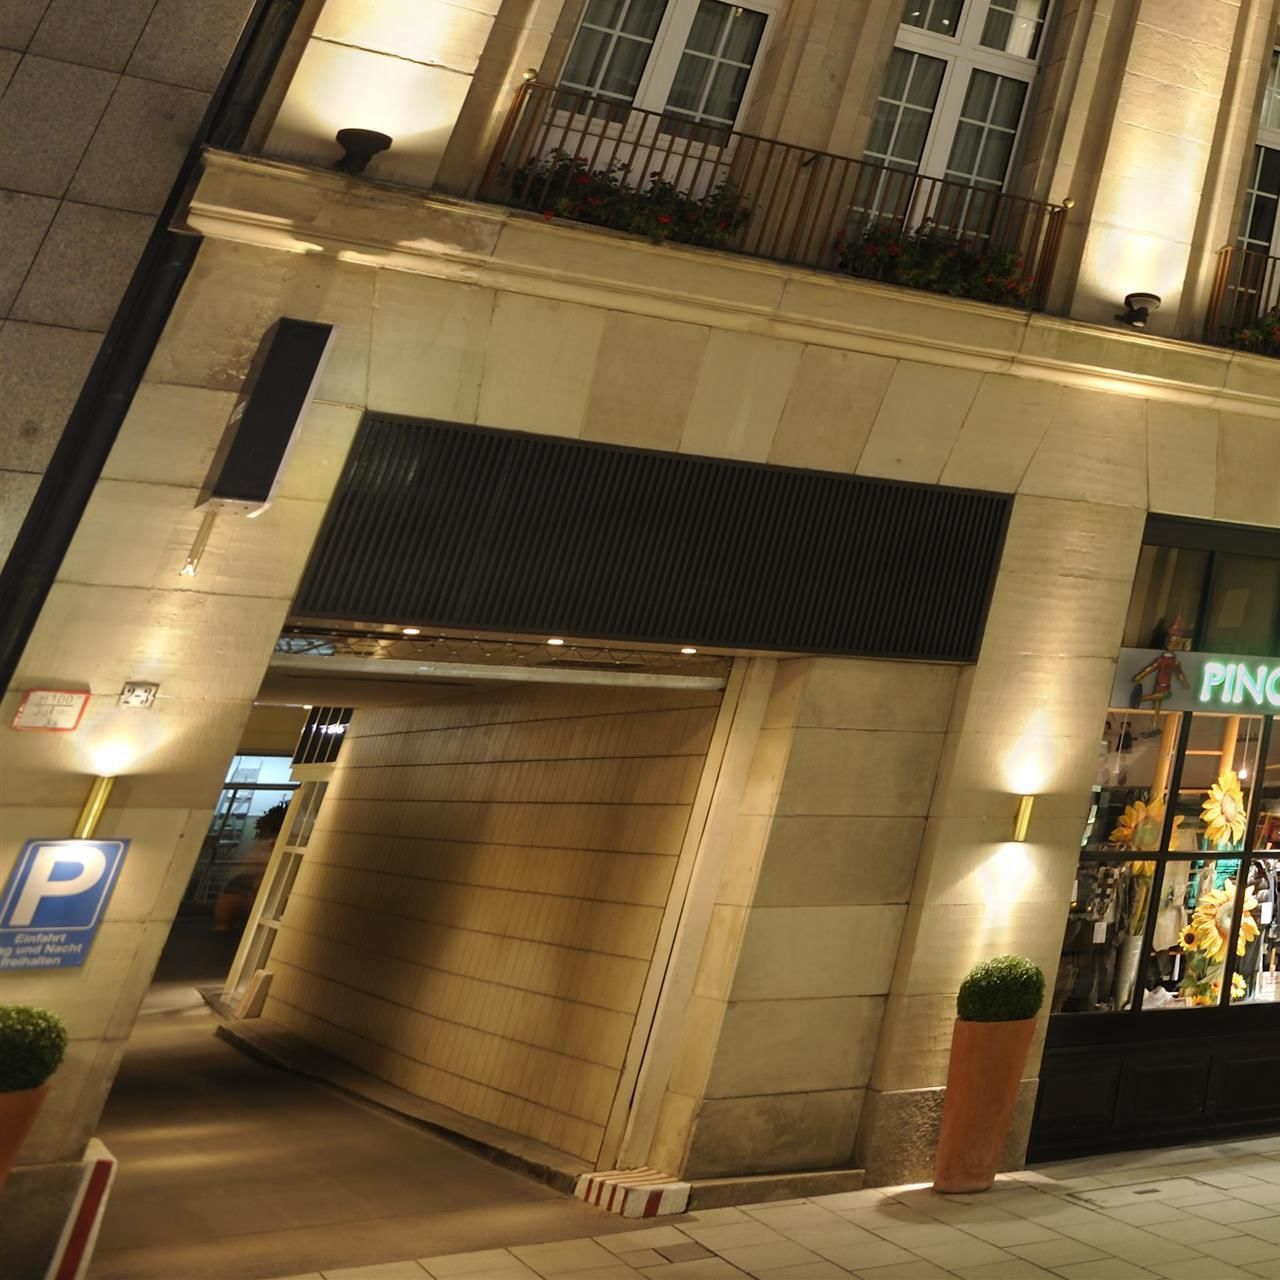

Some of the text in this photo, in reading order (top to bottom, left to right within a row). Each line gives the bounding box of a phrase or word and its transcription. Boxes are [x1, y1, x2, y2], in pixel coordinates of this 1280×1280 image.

[9, 845, 107, 927] P
[15, 933, 67, 944] Einfahrt
[16, 946, 42, 955] und
[44, 943, 83, 955] Nacht
